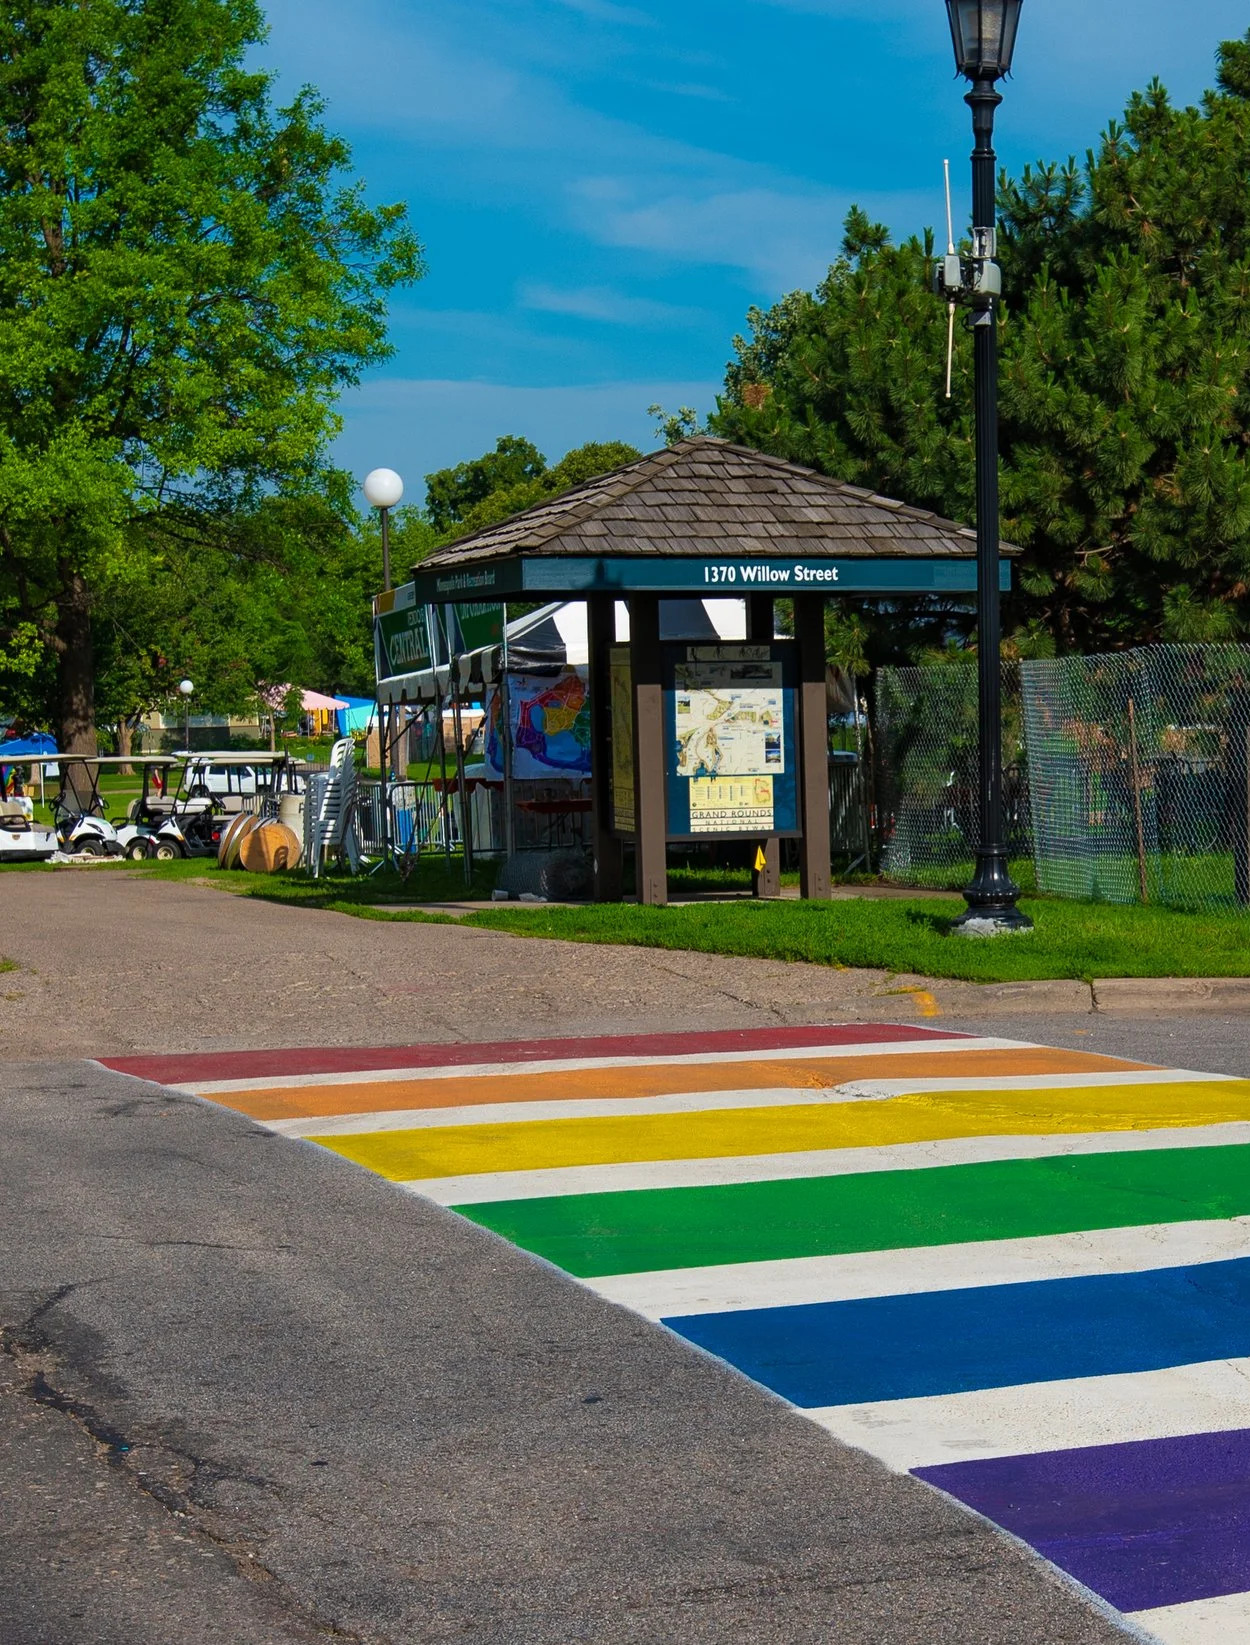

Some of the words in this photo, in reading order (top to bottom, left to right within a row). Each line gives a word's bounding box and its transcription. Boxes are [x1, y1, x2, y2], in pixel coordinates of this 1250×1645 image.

[704, 566, 736, 583] 1370
[740, 565, 790, 582] Willow
[794, 565, 839, 581] Street
[390, 628, 429, 666] CENTRAL
[692, 810, 727, 819] GRAND
[731, 809, 772, 818] ROUNDS
